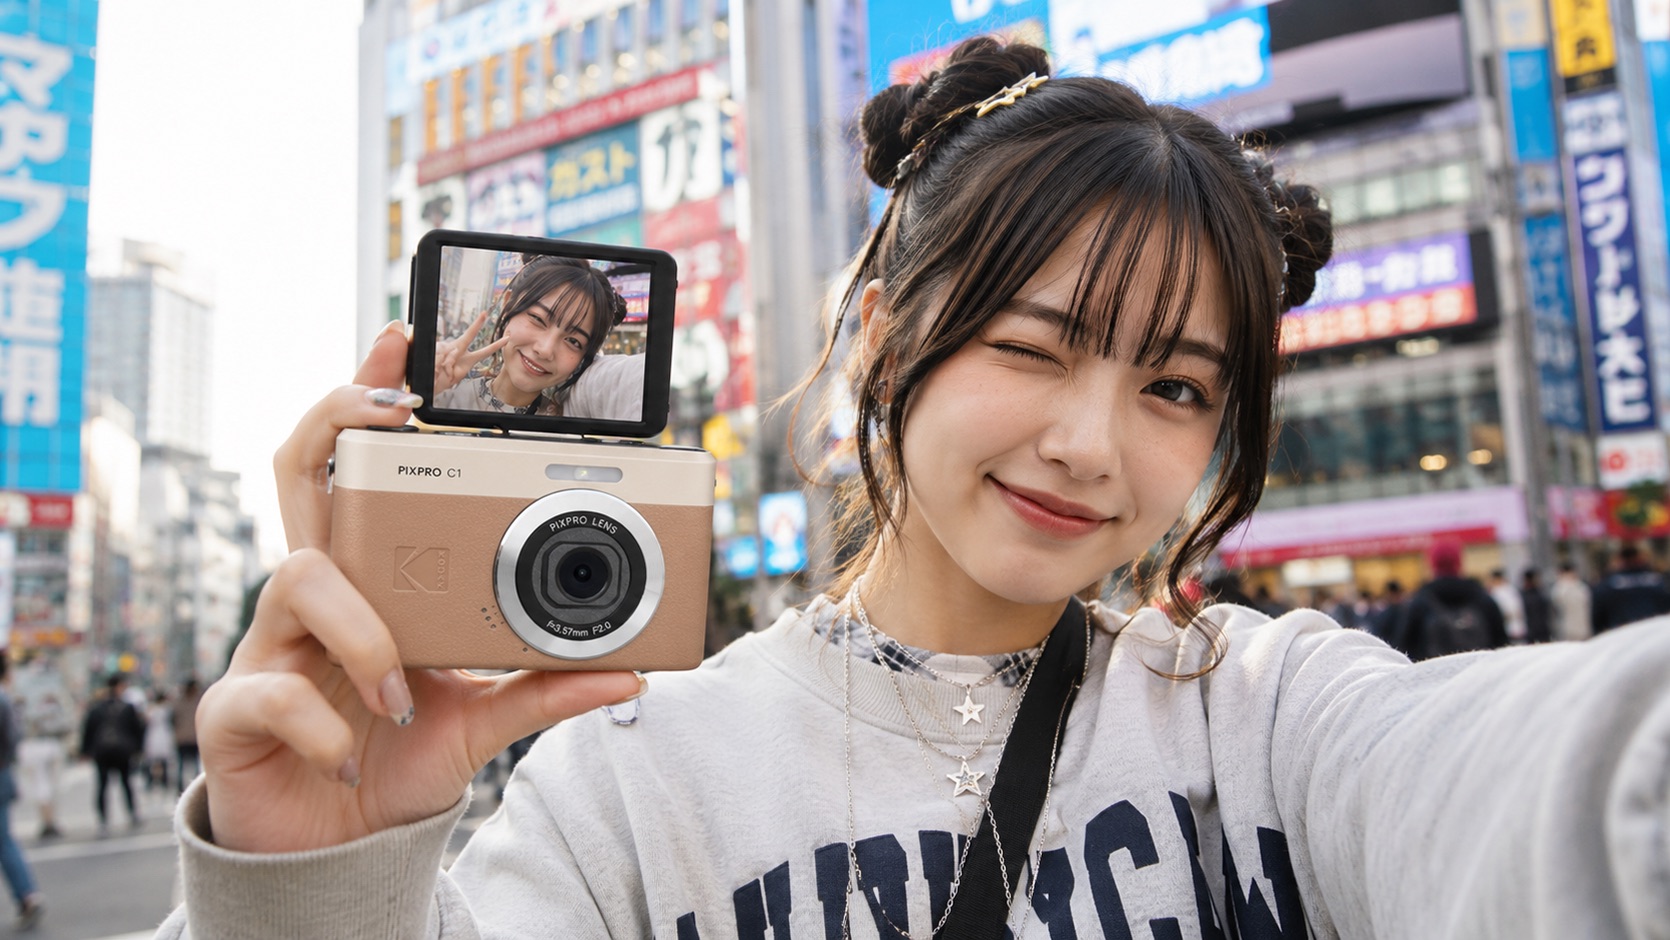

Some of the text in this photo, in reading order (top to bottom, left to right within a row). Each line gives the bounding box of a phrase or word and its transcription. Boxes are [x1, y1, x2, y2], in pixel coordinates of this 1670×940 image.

[398, 465, 461, 478] PIXPRO C1
[549, 515, 618, 534] PIXPRO LENS
[546, 620, 612, 637] f=3.57mm F2.0
